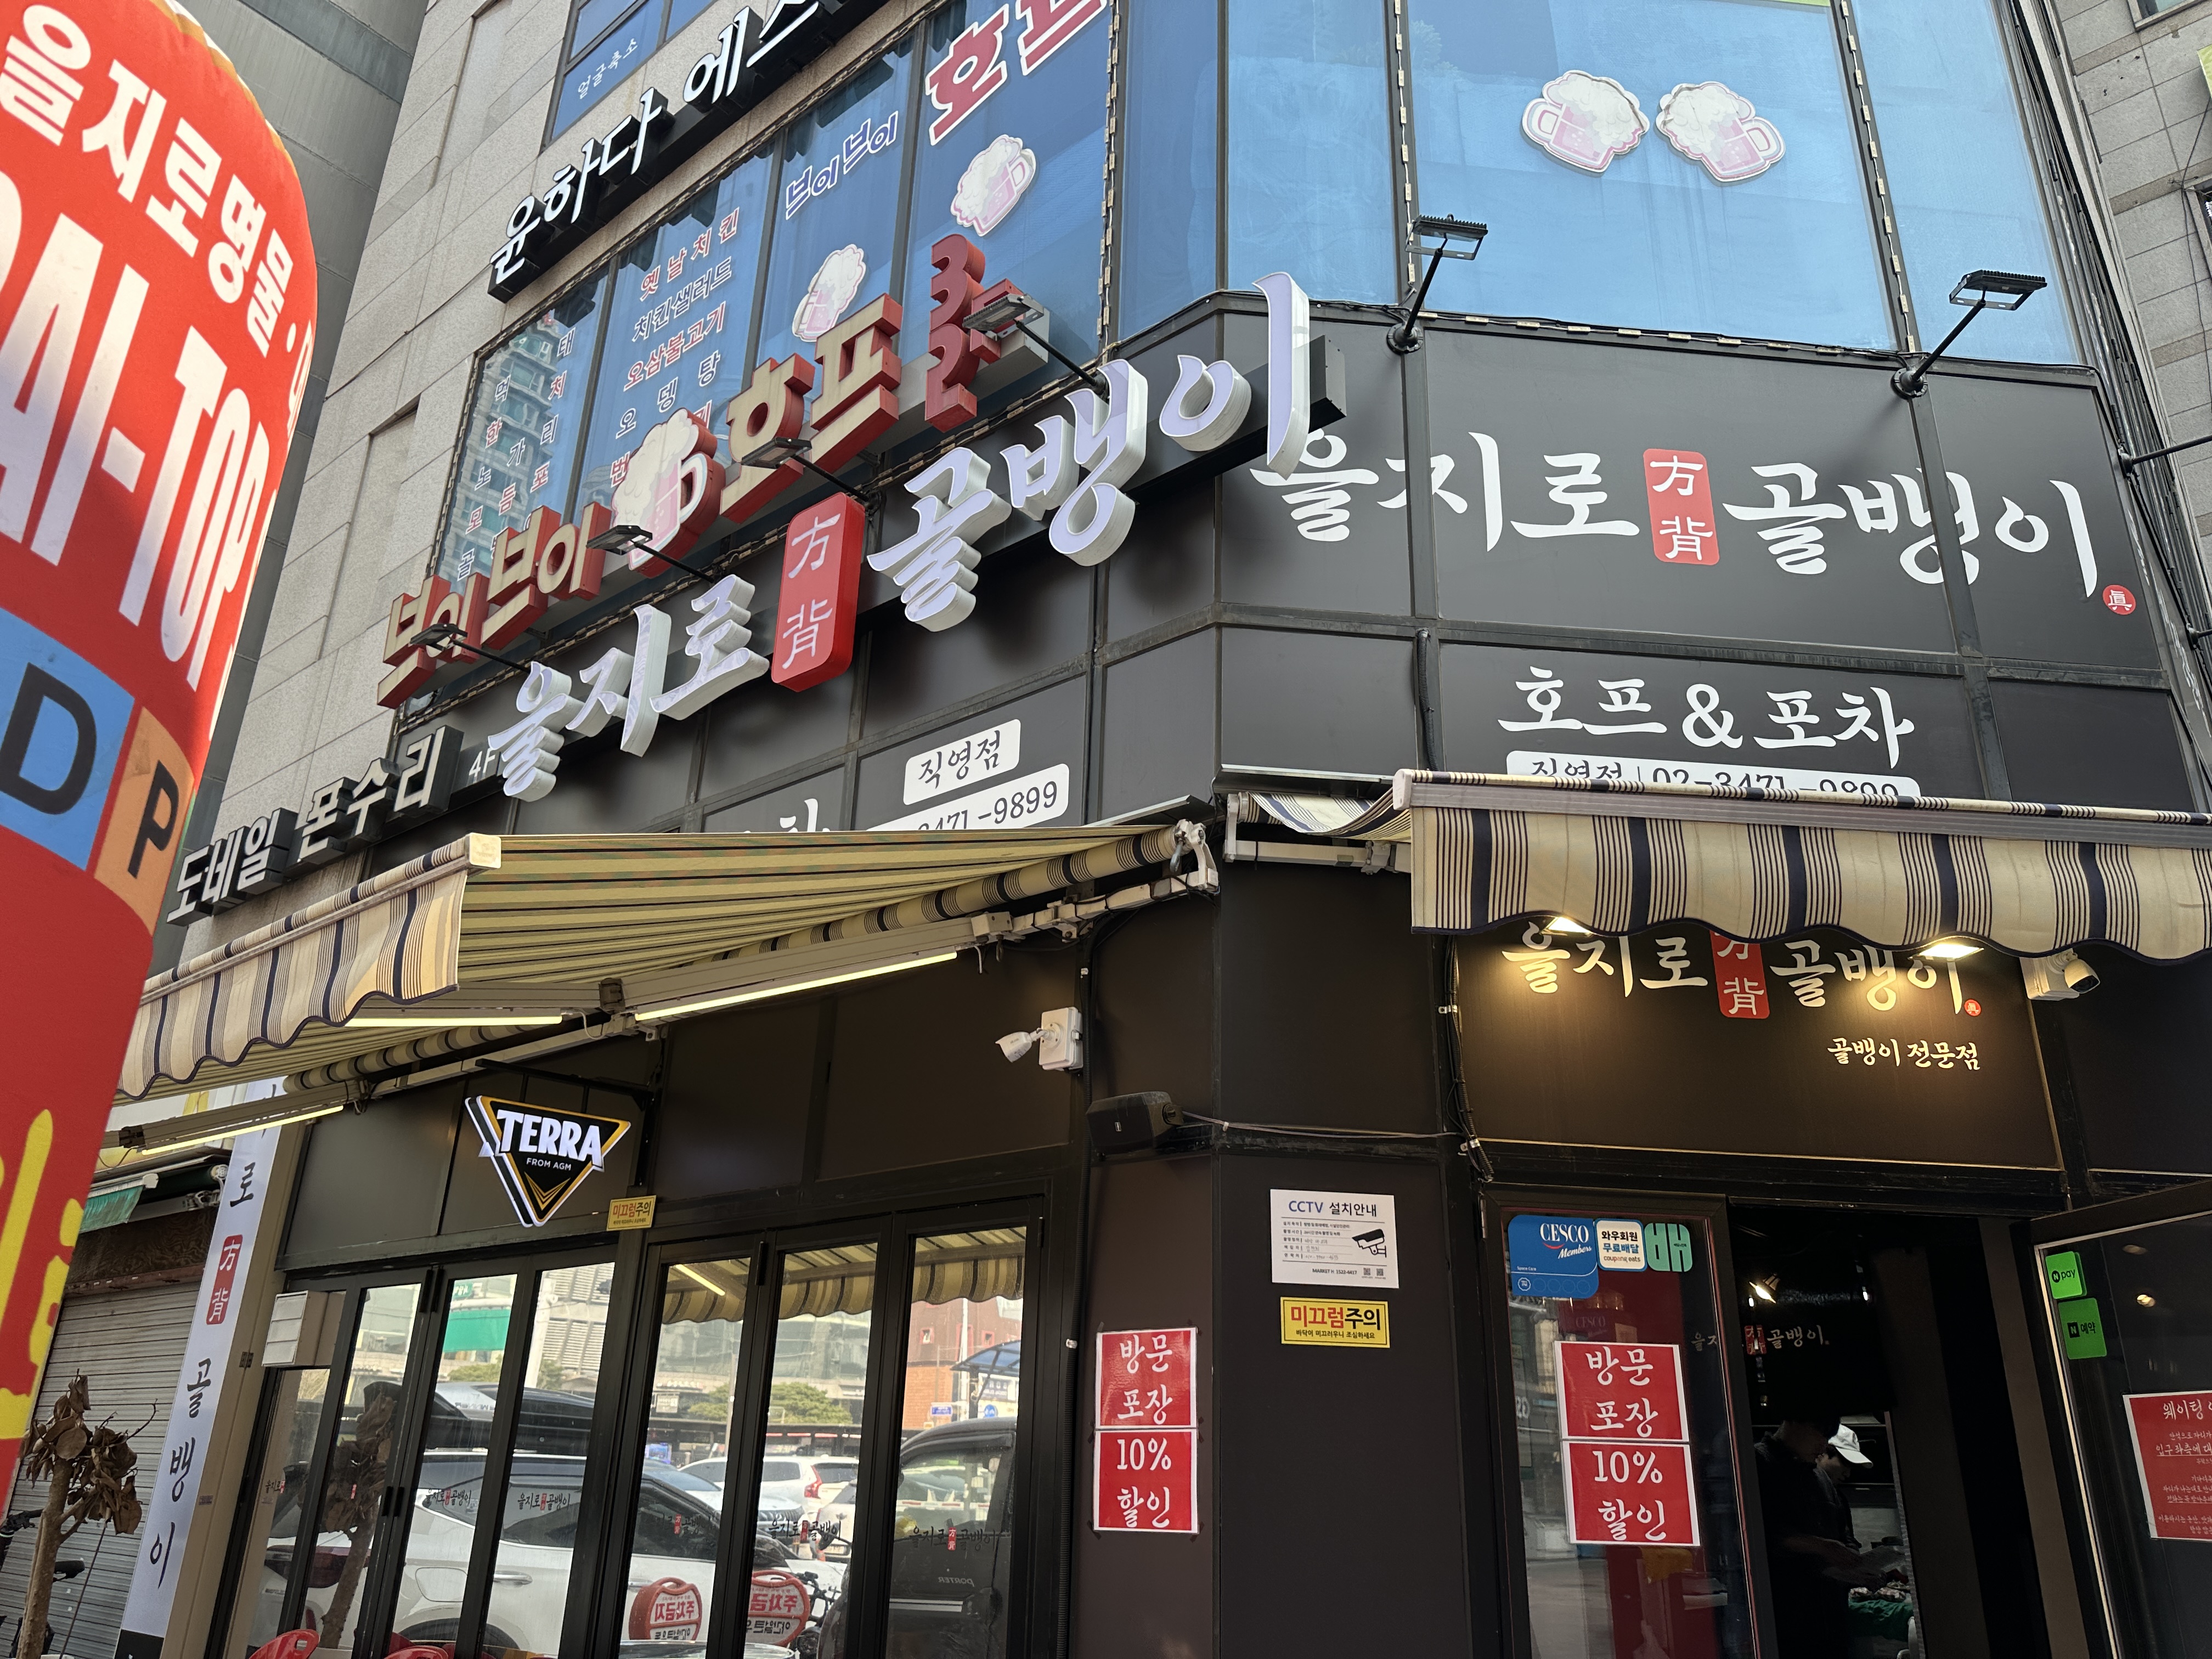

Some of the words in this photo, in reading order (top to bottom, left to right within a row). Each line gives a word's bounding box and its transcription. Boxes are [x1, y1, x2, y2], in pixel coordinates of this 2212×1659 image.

[490, 86, 663, 285] 윤하다
[632, 256, 732, 342] 치킨샐러드
[623, 301, 726, 392] 오삼불고기
[719, 294, 902, 524] 호프
[867, 272, 1311, 632] 골뱅이
[1250, 428, 1640, 552] 을지로
[1650, 455, 1713, 560] 方背
[1723, 462, 2098, 597] 골뱅이
[782, 513, 841, 670] 方背
[488, 574, 769, 802] 을지로
[1498, 665, 1667, 735] 호프
[1682, 684, 1742, 749] &
[1754, 687, 1914, 769] 포차
[469, 747, 496, 777] 4F
[918, 730, 1000, 789] 직영점
[918, 781, 1058, 830] 71-9899
[1502, 922, 1708, 997] 을지로
[1770, 939, 1963, 1014] 골뱅이
[1827, 1037, 1900, 1067] 골뱅이
[1907, 1040, 1980, 1070] 전문점
[496, 1109, 605, 1170] TERRA
[526, 1157, 551, 1168] FROM
[553, 1160, 572, 1171] AGM
[613, 1200, 652, 1219] 미끄럼주의
[1289, 1200, 1324, 1214] CCTV
[1329, 1202, 1377, 1217] 설치안내
[1539, 1222, 1589, 1244] CESCO
[1601, 1231, 1638, 1242] 와우회원
[1602, 1243, 1639, 1254] 무료배달
[1558, 1244, 1592, 1259] Members
[2061, 1269, 2075, 1280] pay
[1290, 1305, 1381, 1330] 미끄럼주의
[2081, 1322, 2096, 1334] 예약
[1346, 1331, 1375, 1339] 조심하세요
[1767, 1324, 1824, 1349] 골뱅이
[1119, 1334, 1173, 1374] 방문
[1585, 1346, 1654, 1386] 방문
[1117, 1384, 1173, 1425] 포장
[1590, 1397, 1658, 1438] 포장
[2163, 1399, 2203, 1420] 웨이팅
[1116, 1437, 1172, 1471] 10%
[2156, 1443, 2173, 1455] 입구
[2175, 1442, 2201, 1455] 좌측에
[1592, 1451, 1663, 1484] 10%
[517, 1492, 540, 1510] 을지로
[546, 1493, 571, 1511] 골뱅이
[1117, 1486, 1170, 1528] 할인
[769, 1519, 800, 1540] 을지로
[808, 1520, 842, 1541] 골뱅이
[1598, 1498, 1667, 1542] 할인
[910, 1525, 947, 1548] 을지로
[957, 1528, 996, 1551] 골뱅이
